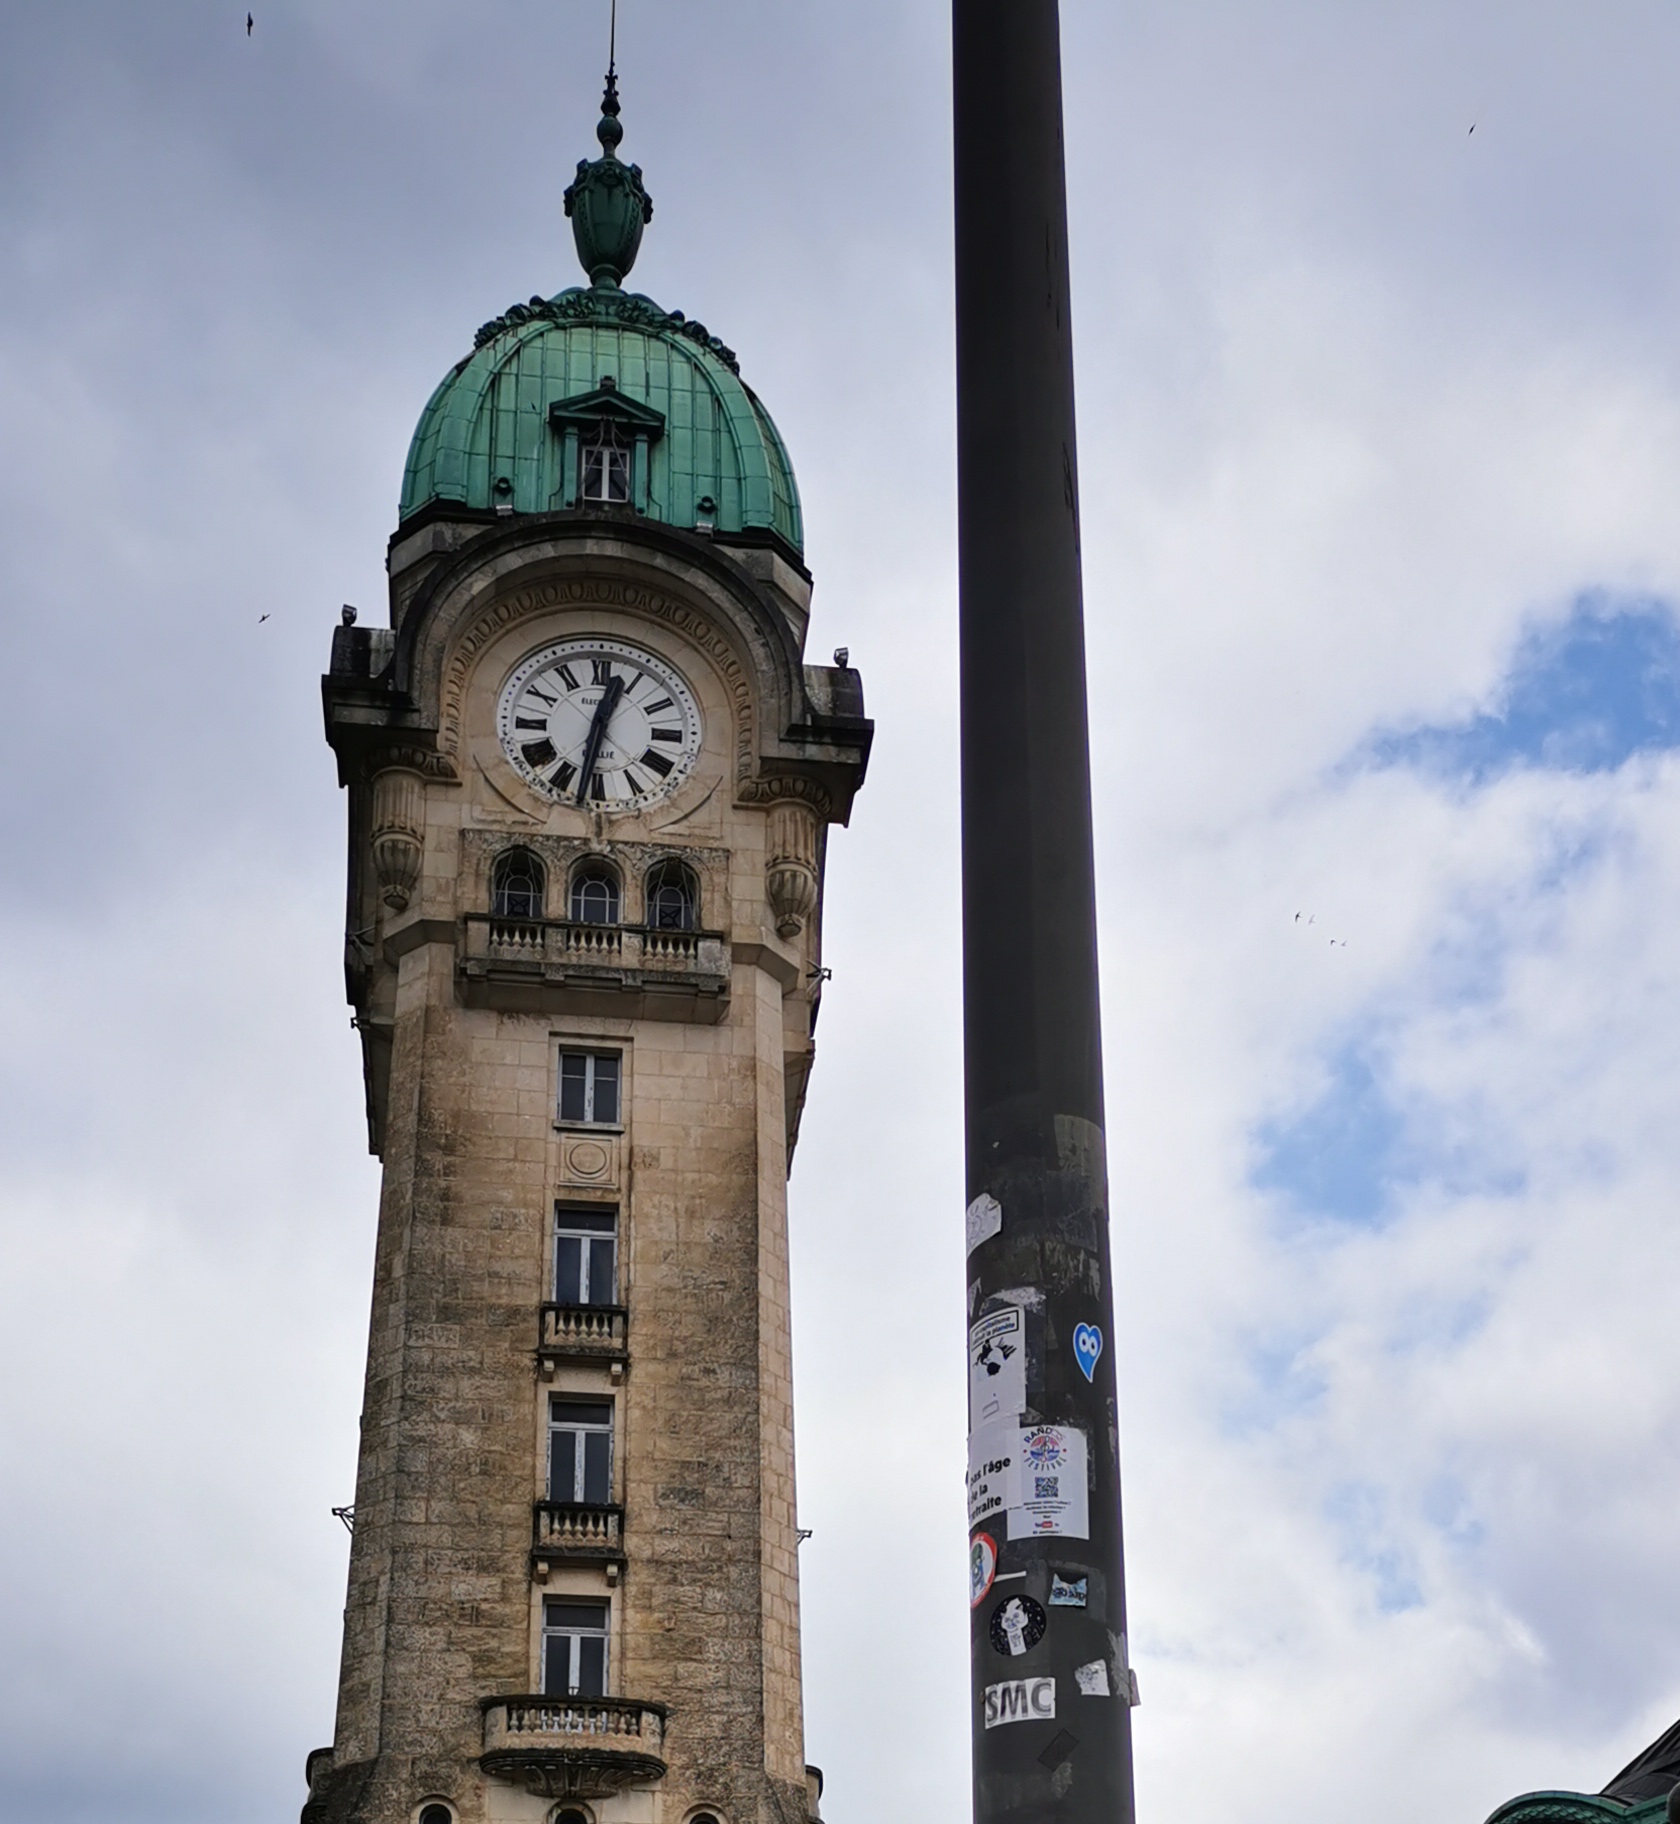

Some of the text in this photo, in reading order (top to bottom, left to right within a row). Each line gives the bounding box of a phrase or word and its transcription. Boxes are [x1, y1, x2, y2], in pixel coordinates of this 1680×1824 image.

[983, 1457, 1011, 1477] l'âge
[1024, 1456, 1067, 1472] FESTIVAL
[986, 1680, 1052, 1724] SMC
